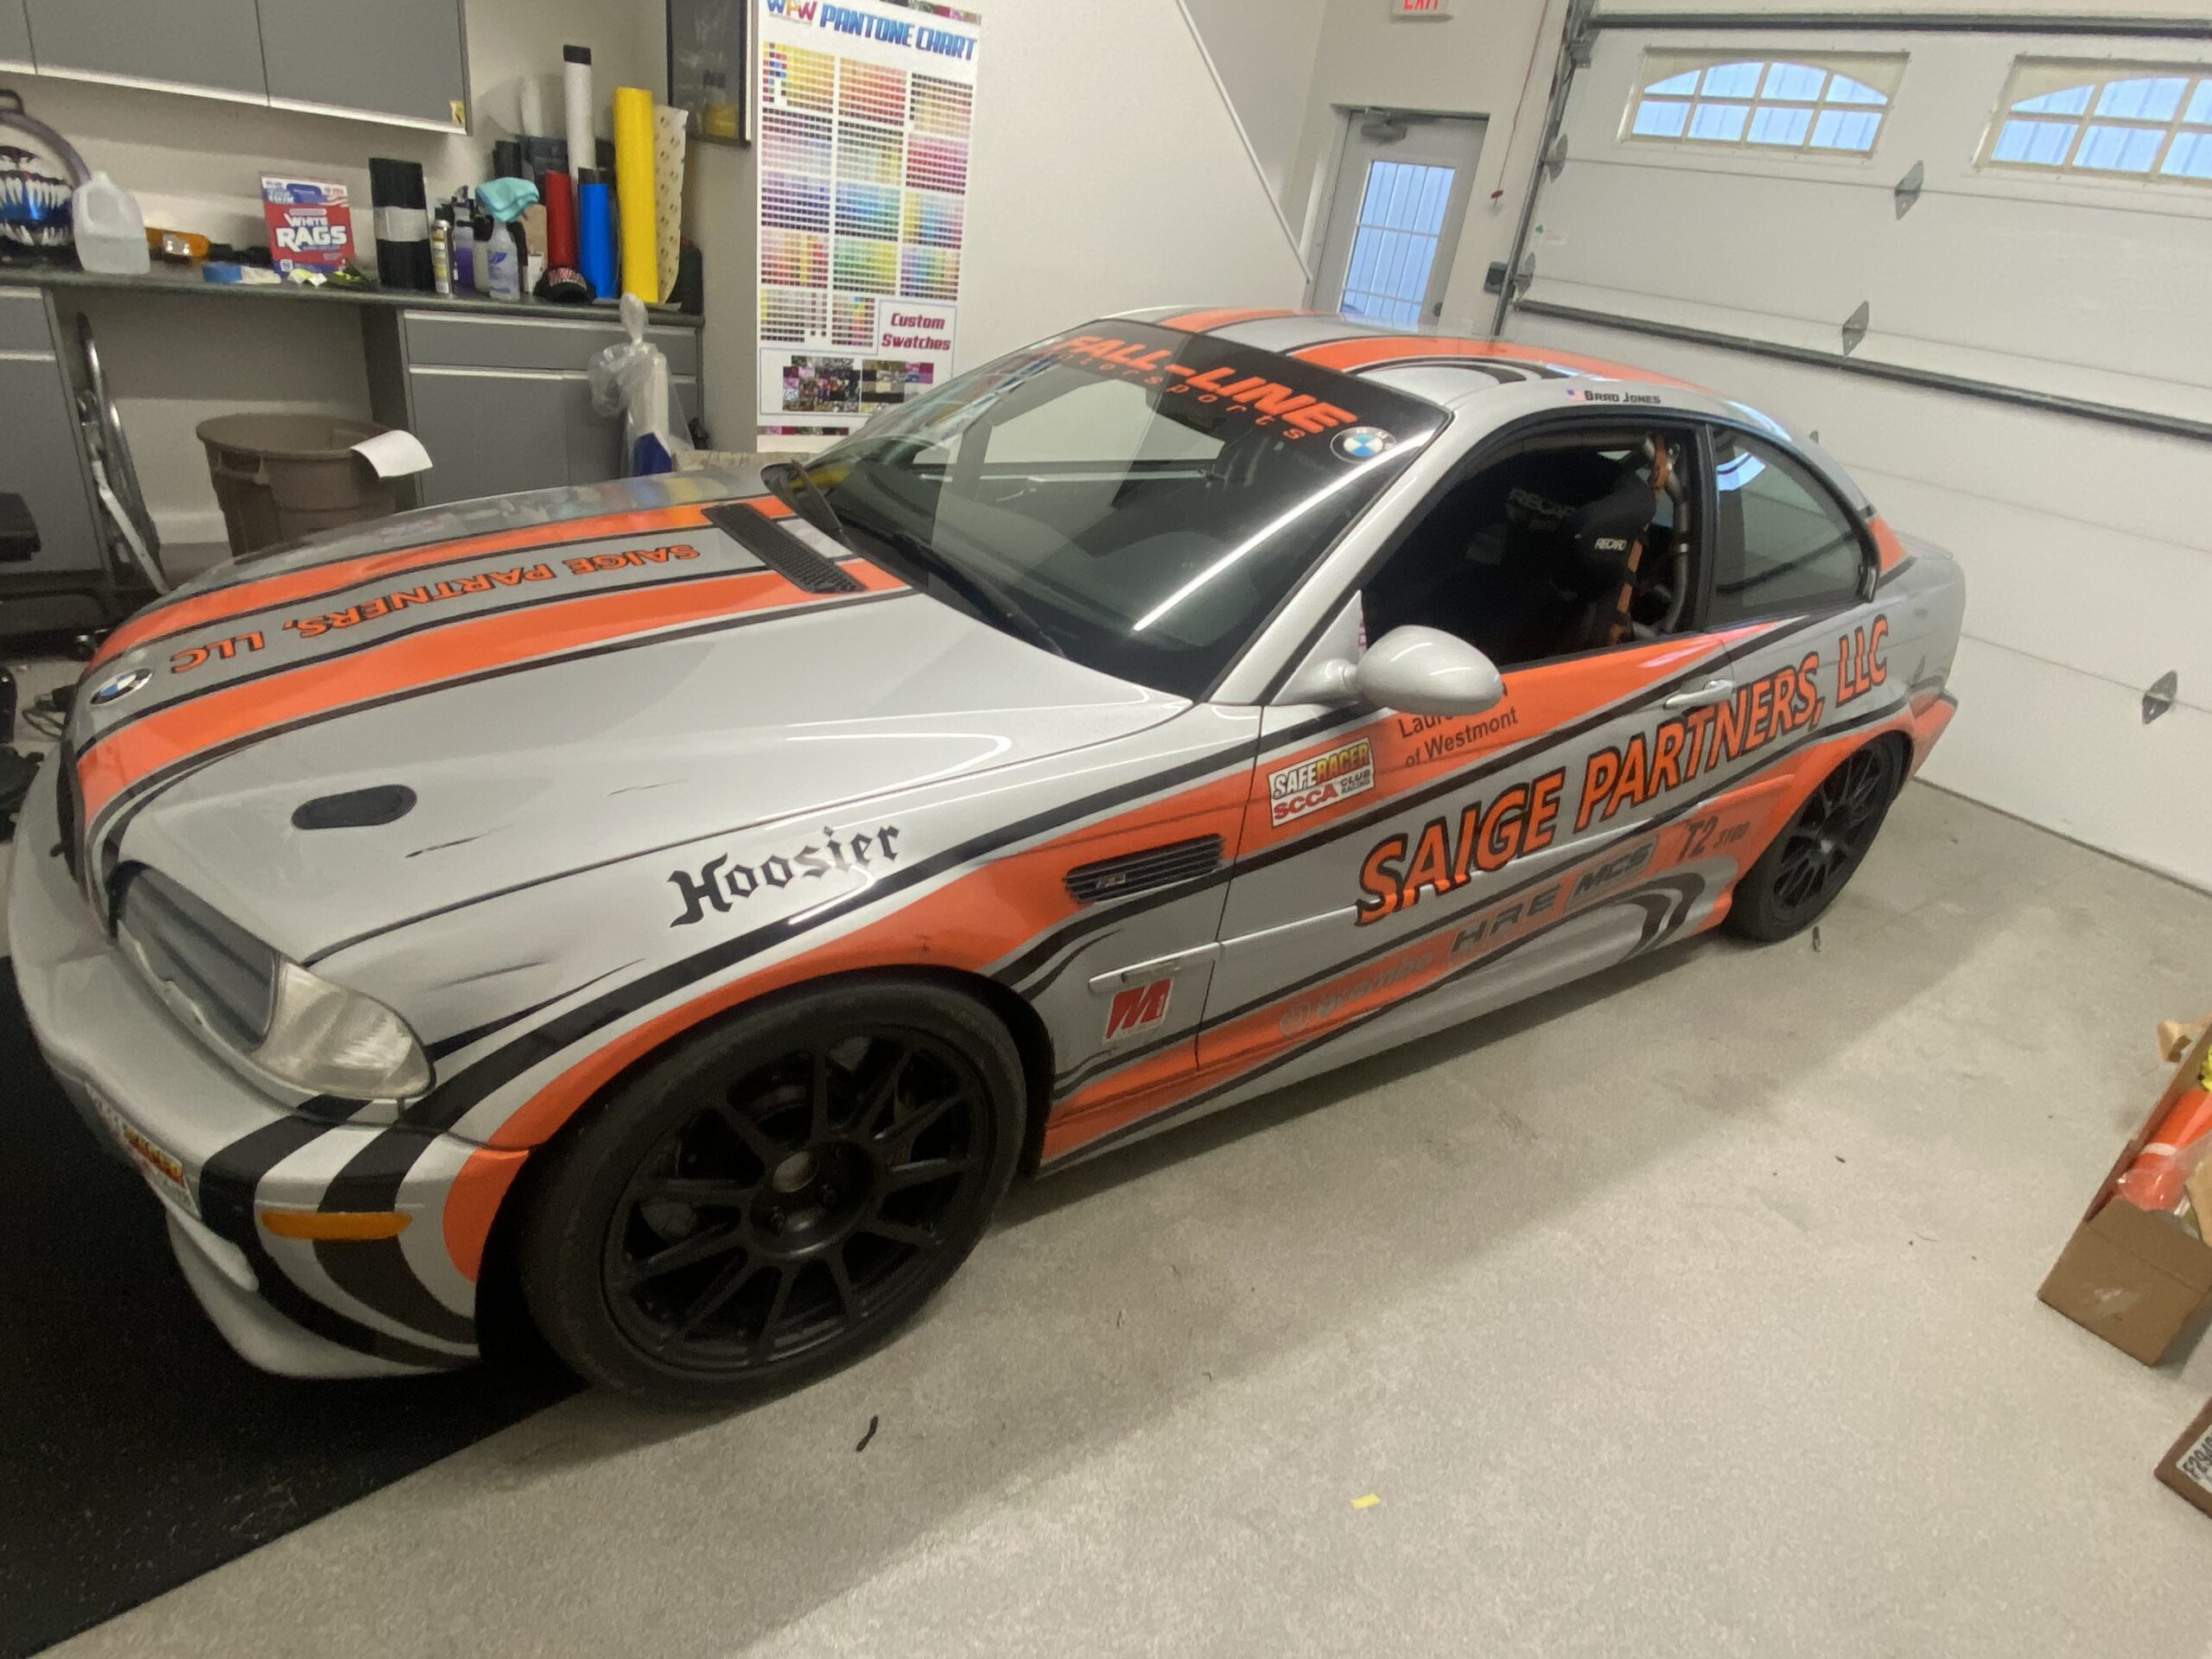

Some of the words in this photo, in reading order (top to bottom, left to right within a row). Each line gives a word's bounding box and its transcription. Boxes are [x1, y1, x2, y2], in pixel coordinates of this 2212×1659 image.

[819, 3, 914, 47] PANTONE
[915, 27, 977, 60] CHART
[276, 226, 347, 252] RAGS
[283, 213, 327, 226] WHITE
[881, 334, 951, 351] Swatches
[891, 313, 945, 329] Custom
[1052, 334, 1358, 434] FALL-LINE
[563, 543, 701, 575] SAIGE
[282, 563, 557, 639] PARTNERS,
[168, 631, 265, 674] LLC
[1405, 751, 1421, 767] of
[1425, 706, 1518, 761] Westmont
[1274, 783, 1340, 820] SCCA
[1340, 769, 1371, 787] CLUB
[1341, 778, 1371, 797] RACING
[1354, 766, 1566, 927] SAIGE
[1573, 651, 1826, 835] PARTNERS,
[1835, 613, 1889, 709] LLC
[1676, 815, 1719, 863] T2
[666, 824, 900, 928] Hoosier
[1573, 841, 1654, 898] MCS
